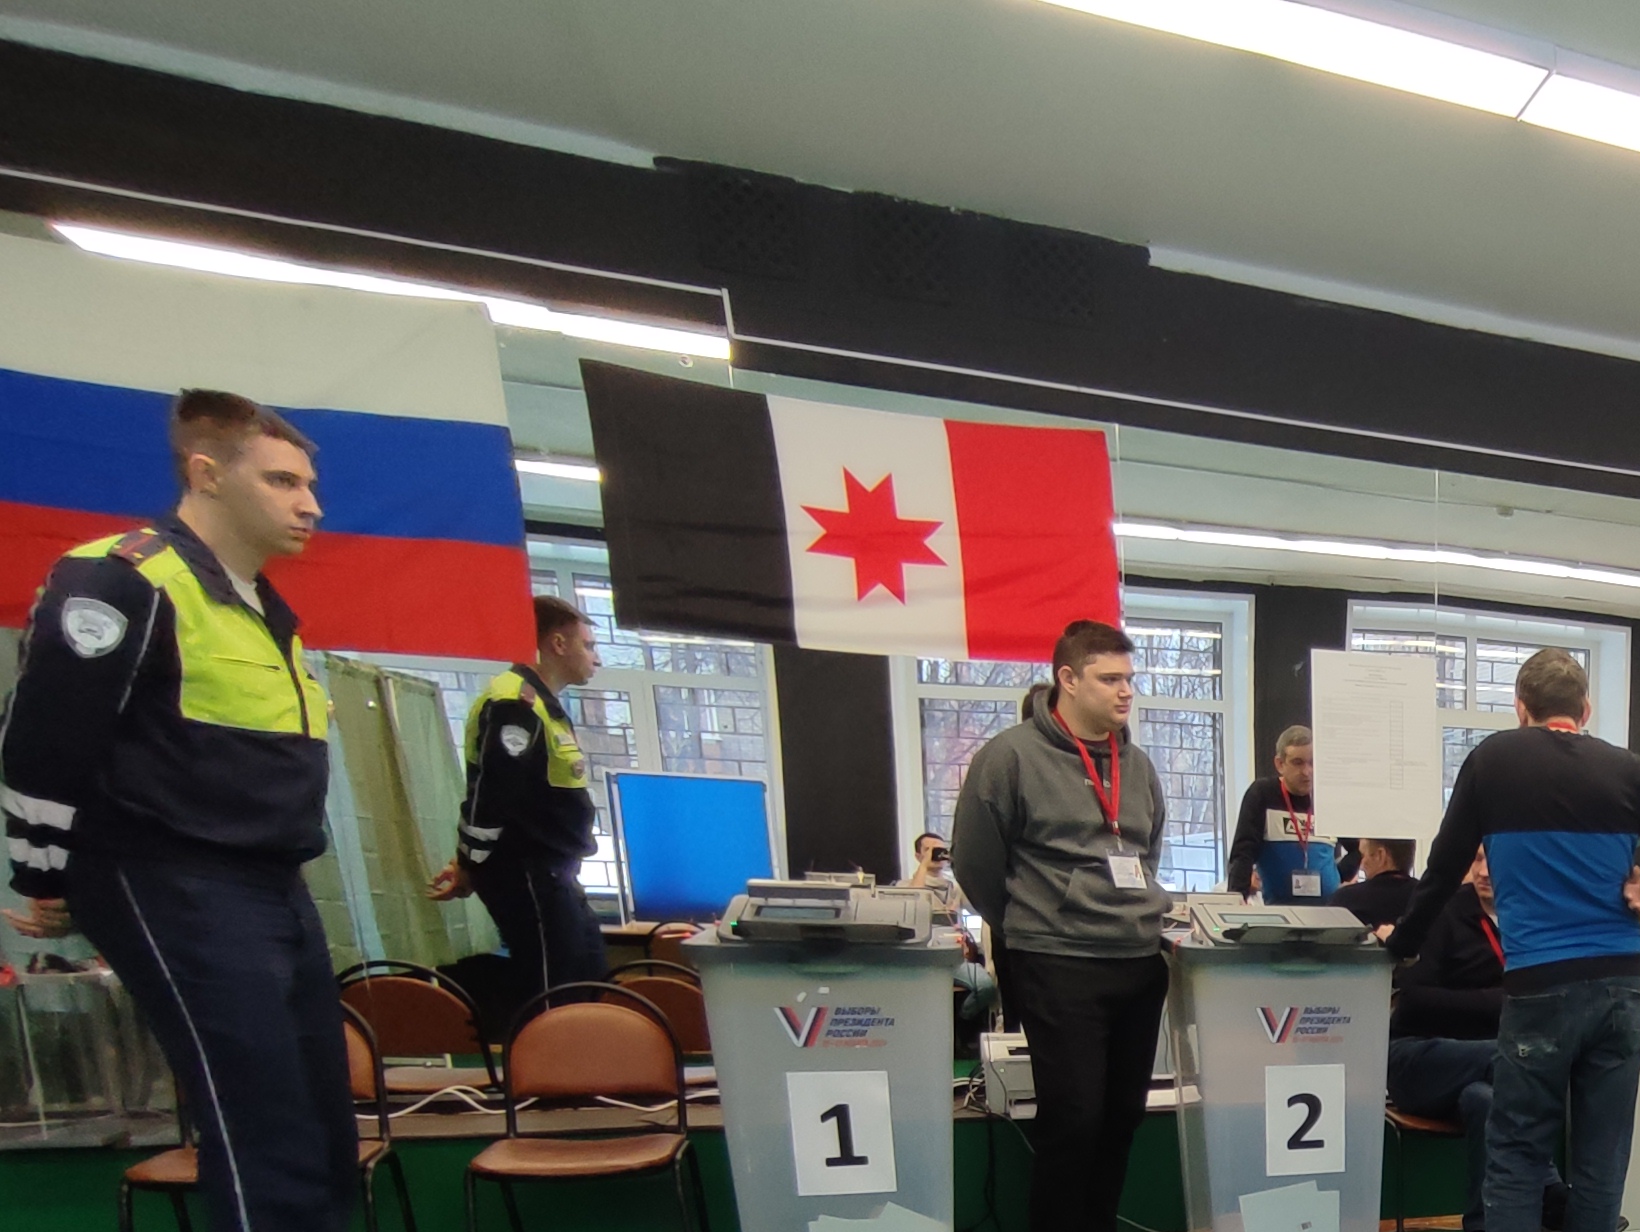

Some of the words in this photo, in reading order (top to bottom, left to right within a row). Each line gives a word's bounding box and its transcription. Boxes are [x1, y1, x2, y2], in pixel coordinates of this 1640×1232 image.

[834, 1006, 882, 1016] ВЫБОРЫ
[1303, 1006, 1341, 1015] ВЫБОРЫ
[829, 1017, 896, 1027] ПРЕЗИДЕНТА
[1298, 1016, 1351, 1025] ПРЕЗИДЕНТА
[825, 1029, 869, 1038] РОССИИ
[1294, 1026, 1329, 1035] РОССИИ
[1286, 1092, 1325, 1151] 2
[820, 1103, 869, 1168] 1
